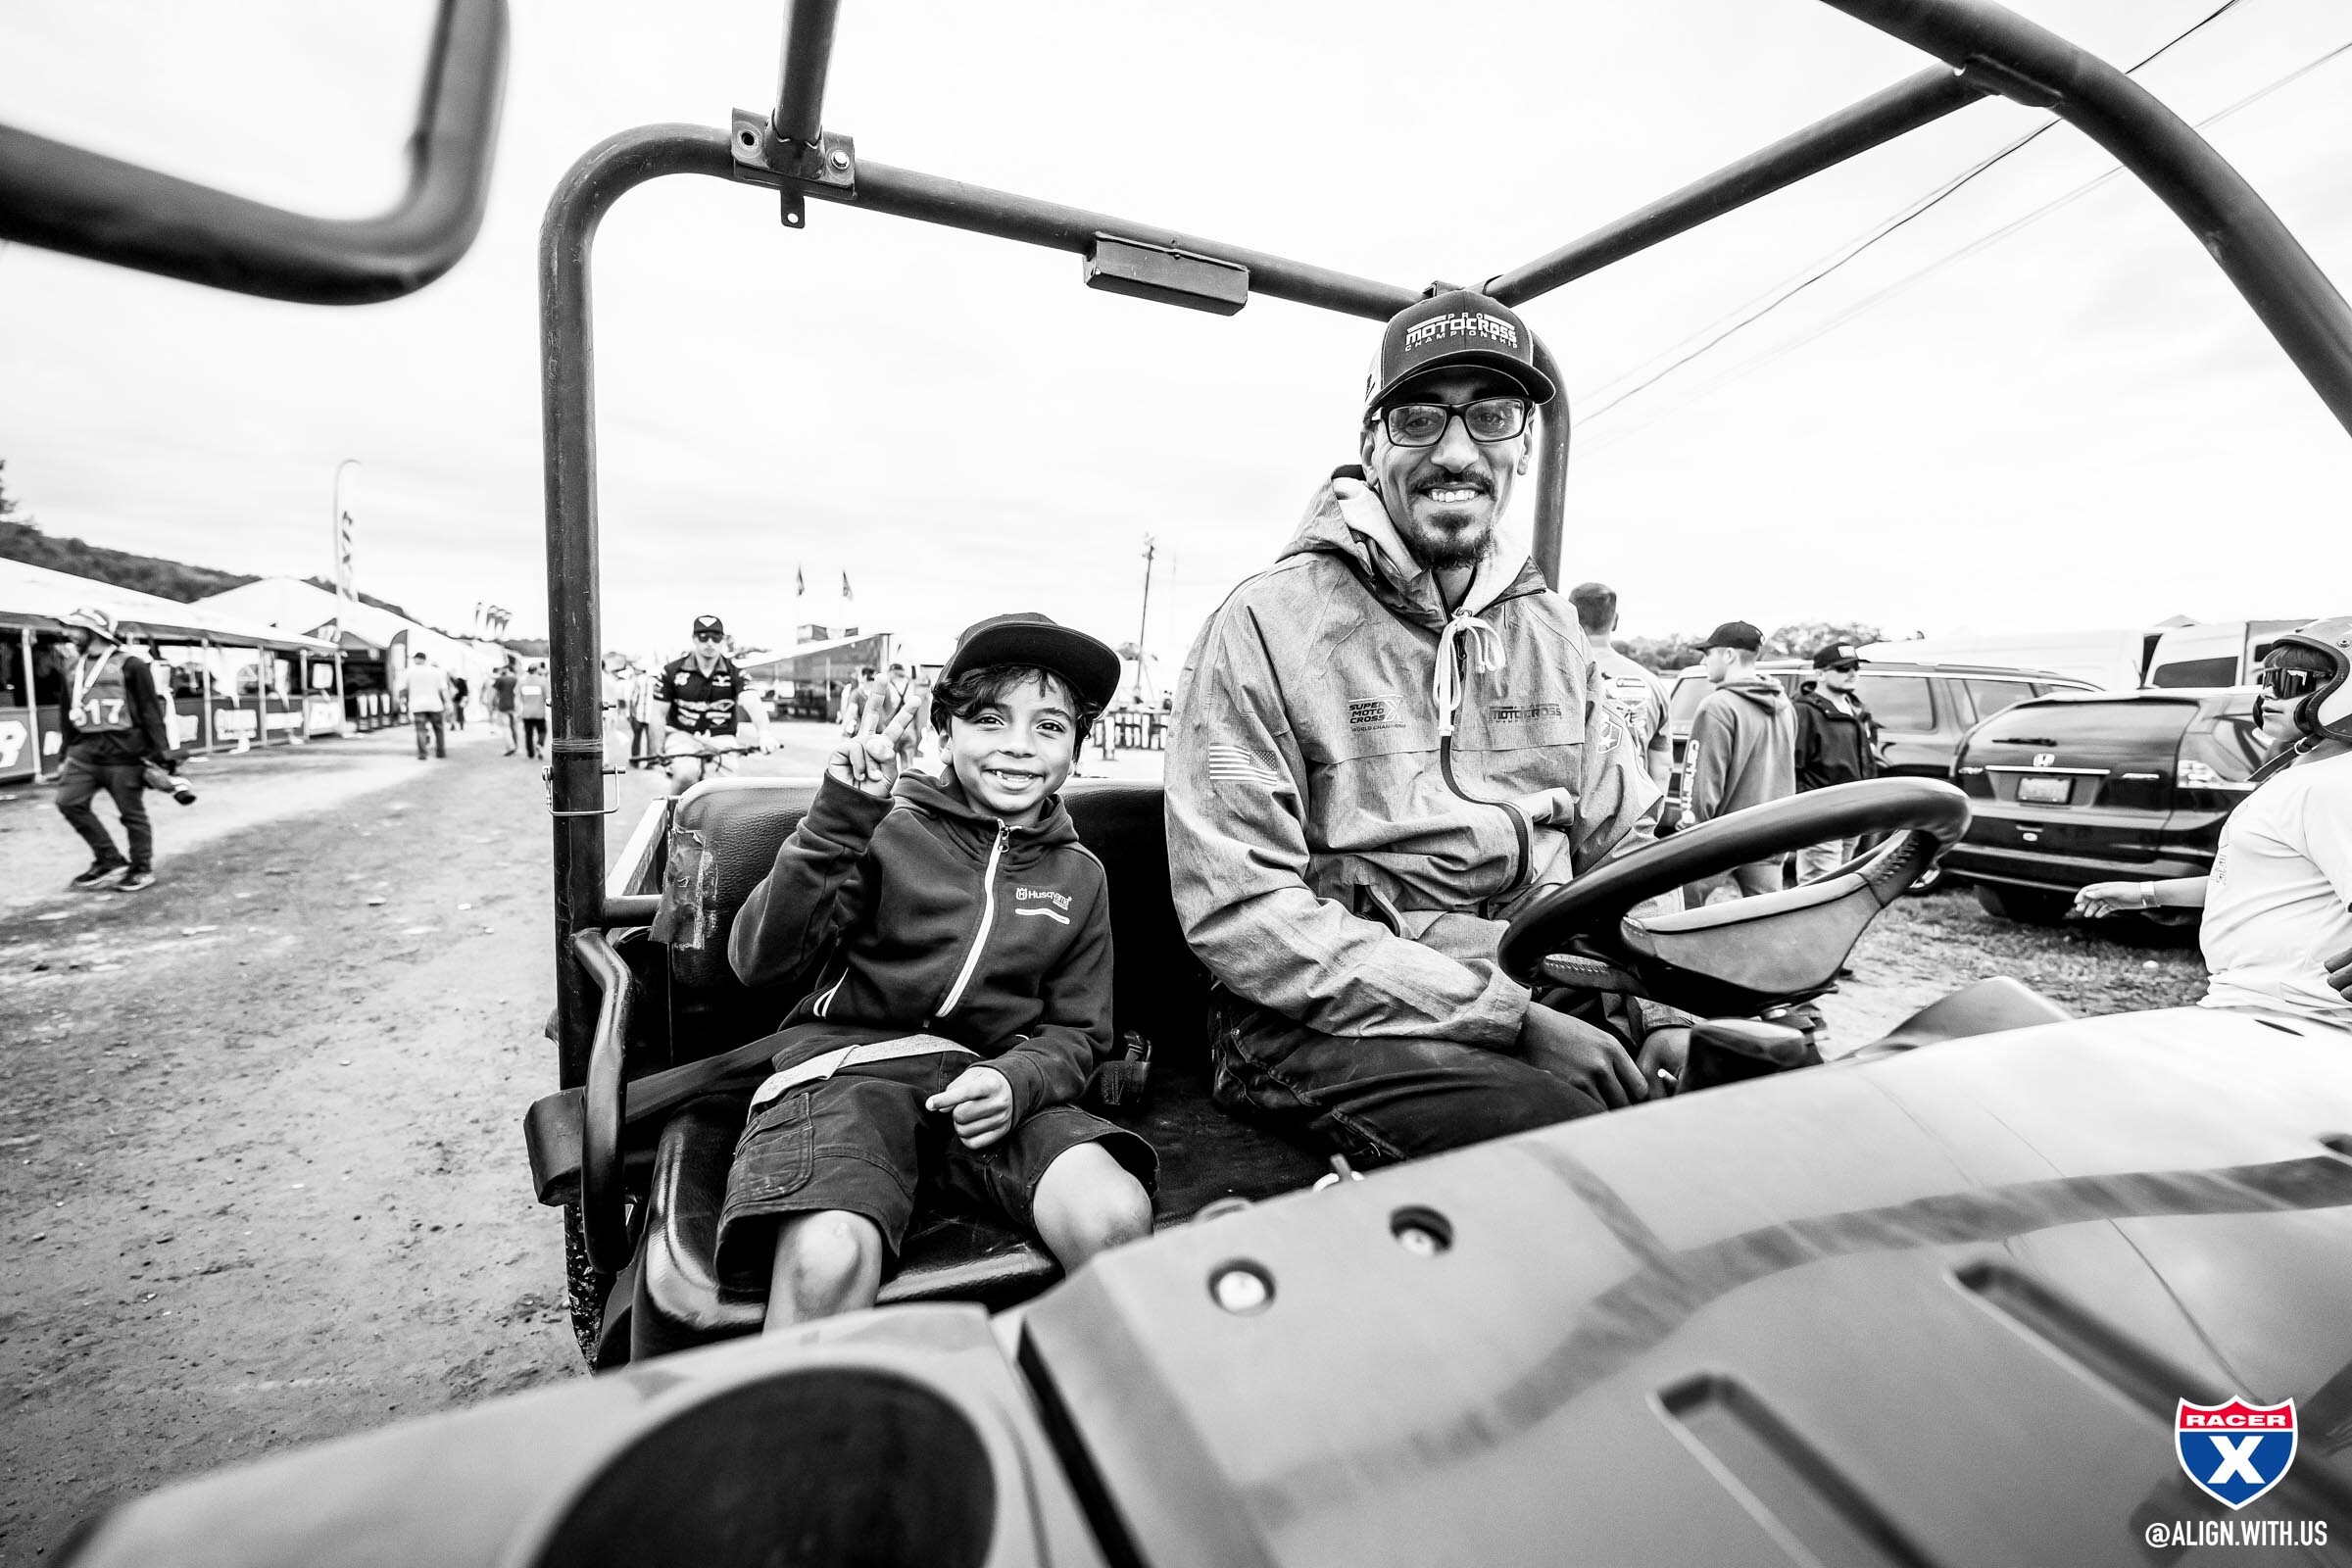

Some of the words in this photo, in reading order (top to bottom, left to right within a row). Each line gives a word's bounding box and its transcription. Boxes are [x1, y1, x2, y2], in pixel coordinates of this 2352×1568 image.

[1447, 312, 1484, 320] PRO
[1405, 318, 1518, 346] MOTOCROSS
[1404, 329, 1518, 352] CHAMPIONSHIP
[1348, 701, 1384, 711] SUPER
[1351, 708, 1385, 717] MOTO
[1488, 707, 1562, 720] MOTOCROSS
[1349, 714, 1386, 724] CROSS
